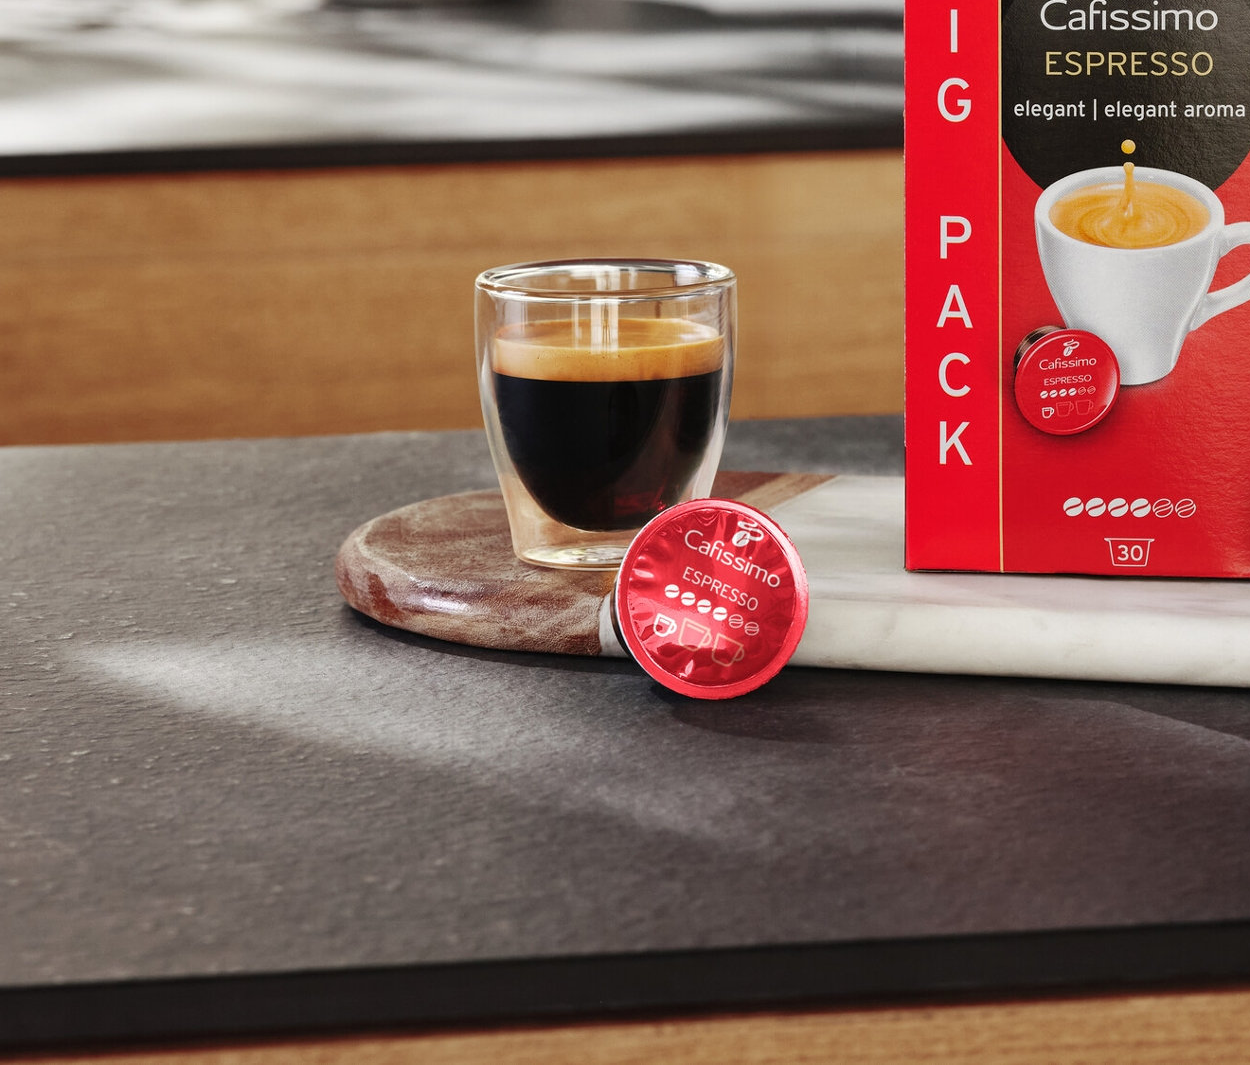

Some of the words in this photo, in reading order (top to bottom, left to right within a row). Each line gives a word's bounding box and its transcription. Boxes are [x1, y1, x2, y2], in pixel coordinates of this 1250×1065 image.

[1045, 51, 1214, 77] ESPRESSO
[1013, 99, 1086, 121] elegant
[1104, 100, 1177, 122] elegant
[1183, 104, 1246, 118] aroma
[936, 215, 973, 466] PACK
[1039, 357, 1097, 370] Cafissimo
[1043, 374, 1092, 386] ESPRESSO
[684, 529, 781, 588] Cafissimo
[1116, 544, 1143, 561] 30
[682, 566, 759, 611] ESPRESSO
